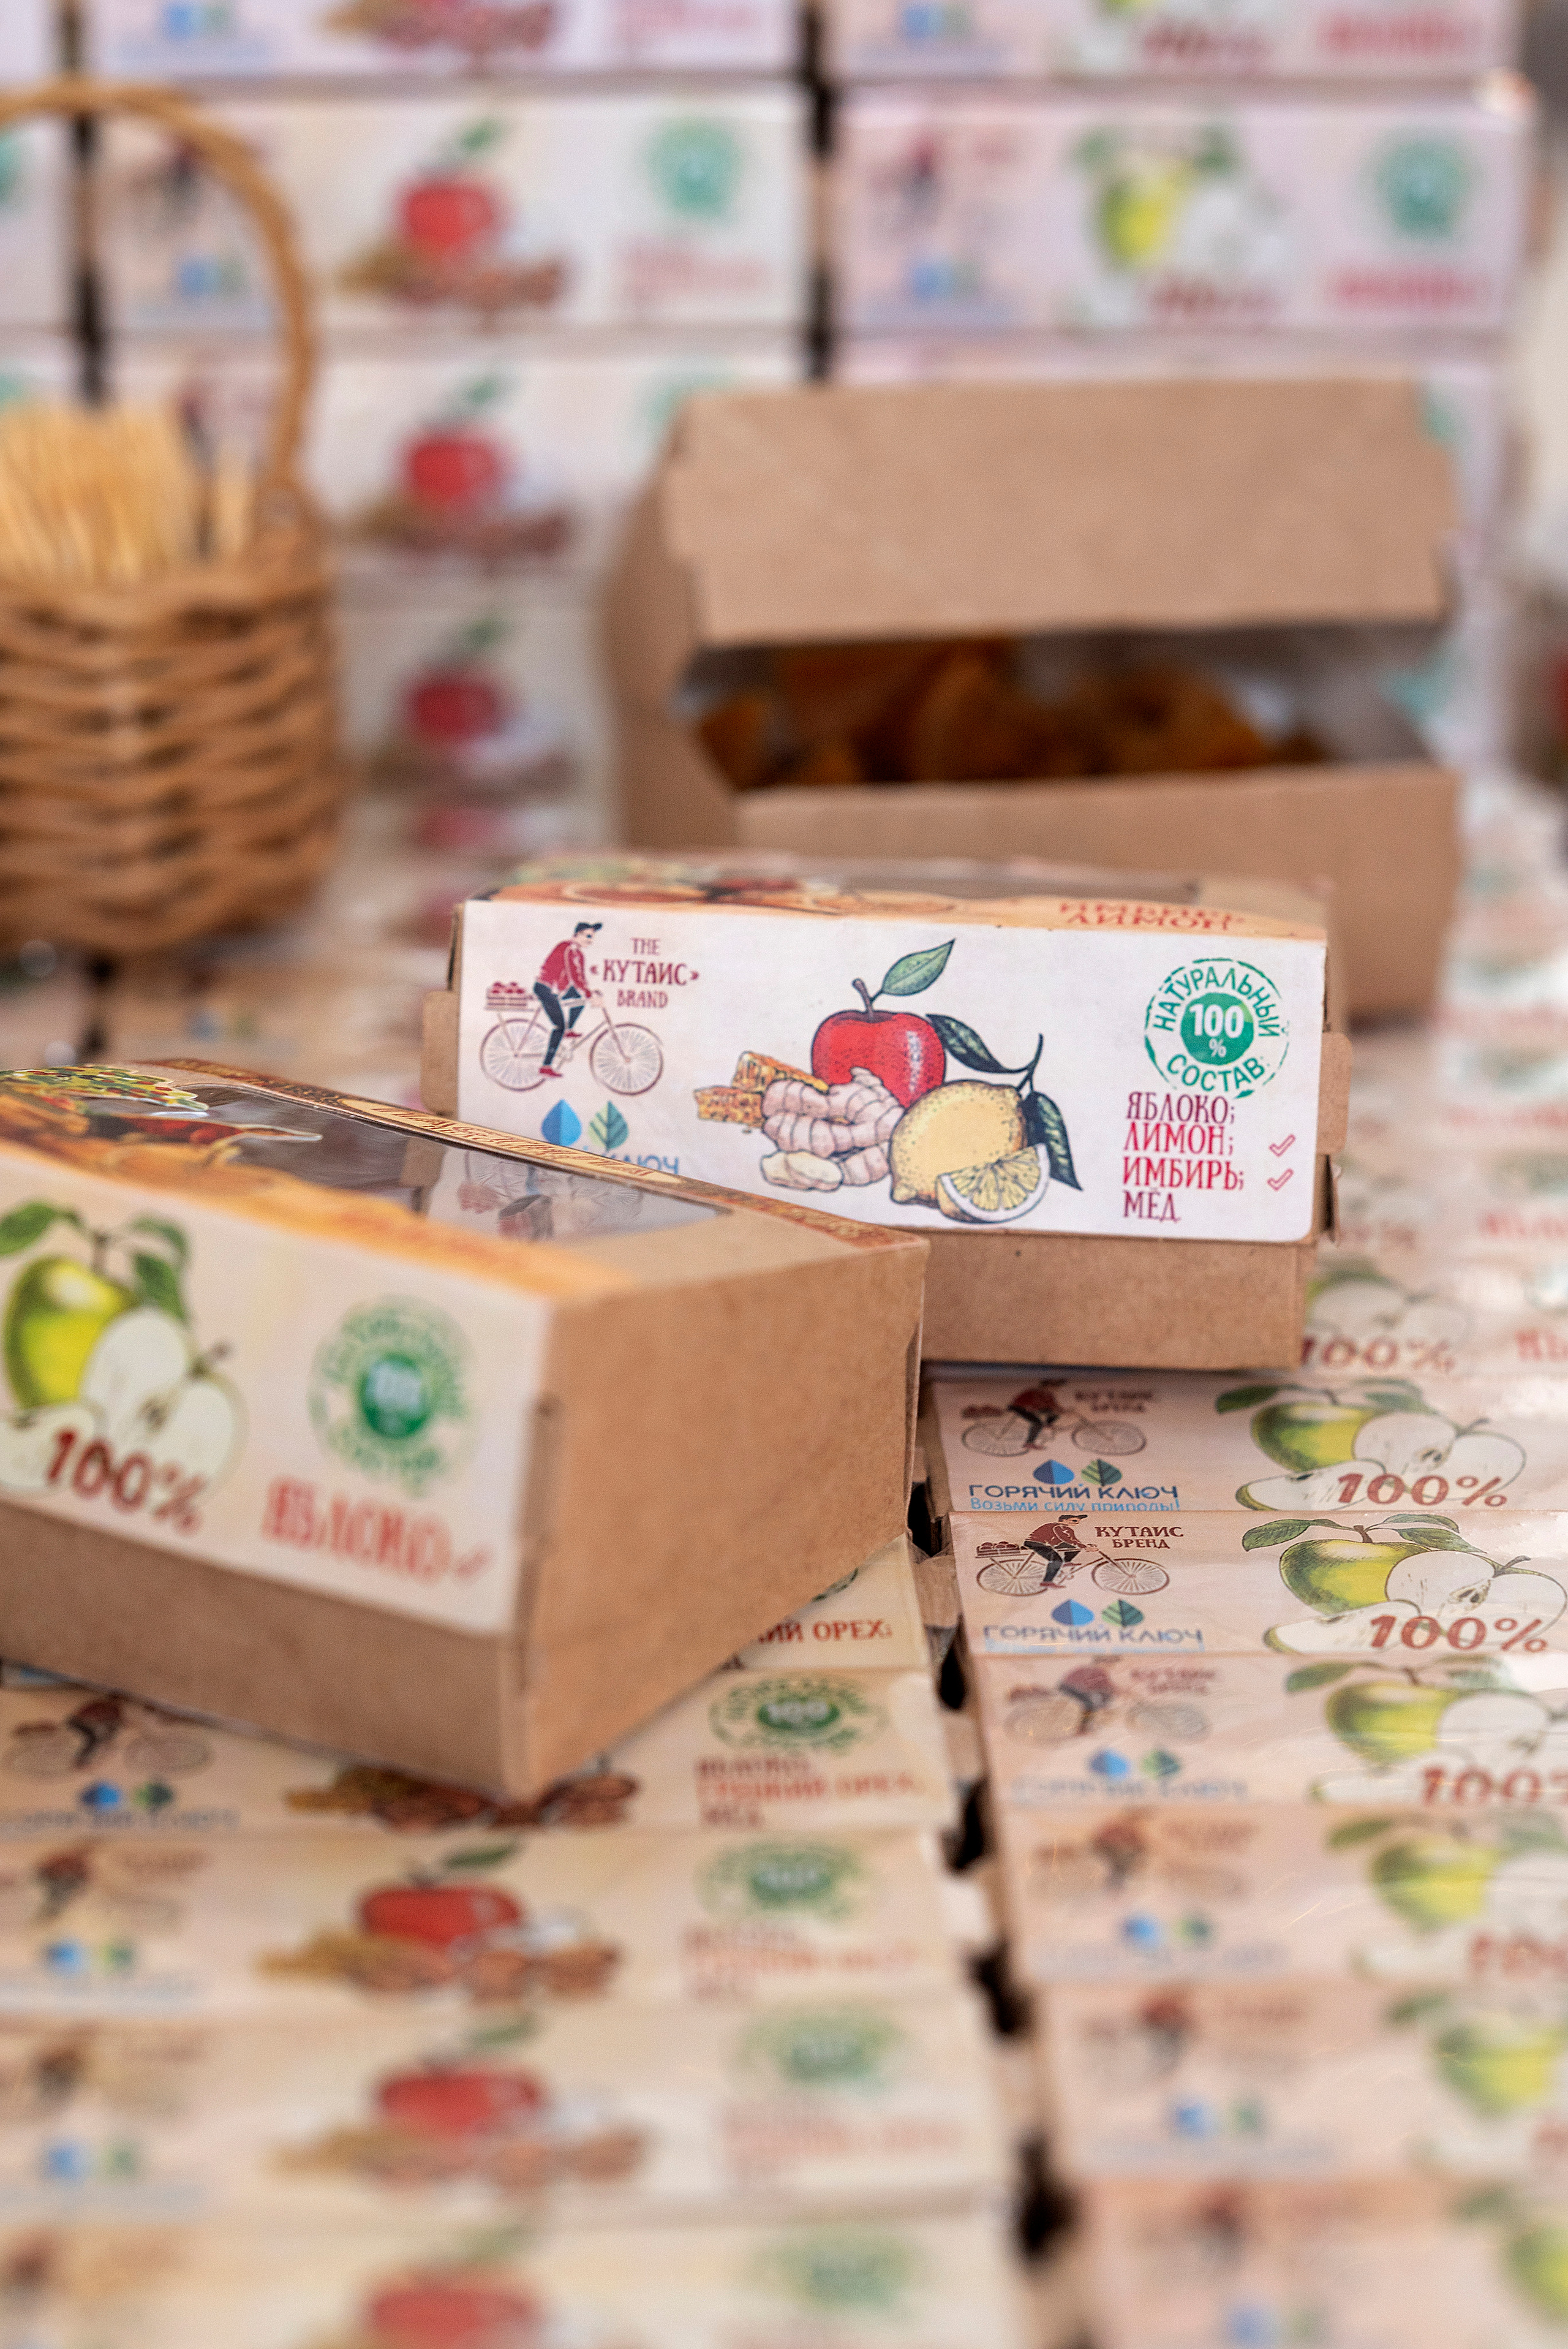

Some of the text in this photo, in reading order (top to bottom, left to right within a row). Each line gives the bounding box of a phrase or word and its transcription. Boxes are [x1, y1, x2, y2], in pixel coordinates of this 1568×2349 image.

[631, 937, 660, 956] THE
[617, 988, 669, 1008] BRAND
[1153, 966, 1286, 1037] НАТУРАЛЬНЫЙ
[1189, 1003, 1245, 1039] 100
[1166, 1053, 1265, 1092] СОСТАВ
[1126, 1091, 1235, 1125] ЯБЛОКО;
[1123, 1121, 1234, 1156] ЛИМОН;
[1123, 1155, 1244, 1190] ИМБИРЬ;
[1124, 1187, 1182, 1222] МЁД
[45, 1428, 204, 1535] 100%
[969, 1483, 1178, 1500] ГОРЯЧИЙ КЛЮЧ
[1337, 1473, 1507, 1507] 100%
[970, 1497, 1039, 1511] Возьми
[1094, 1526, 1185, 1538] КУТАИС
[1112, 1538, 1170, 1549] БРЕНД
[983, 1624, 1205, 1643] ГОРЯЧИЙ КЛЮЧ
[1369, 1615, 1549, 1654] 100%
